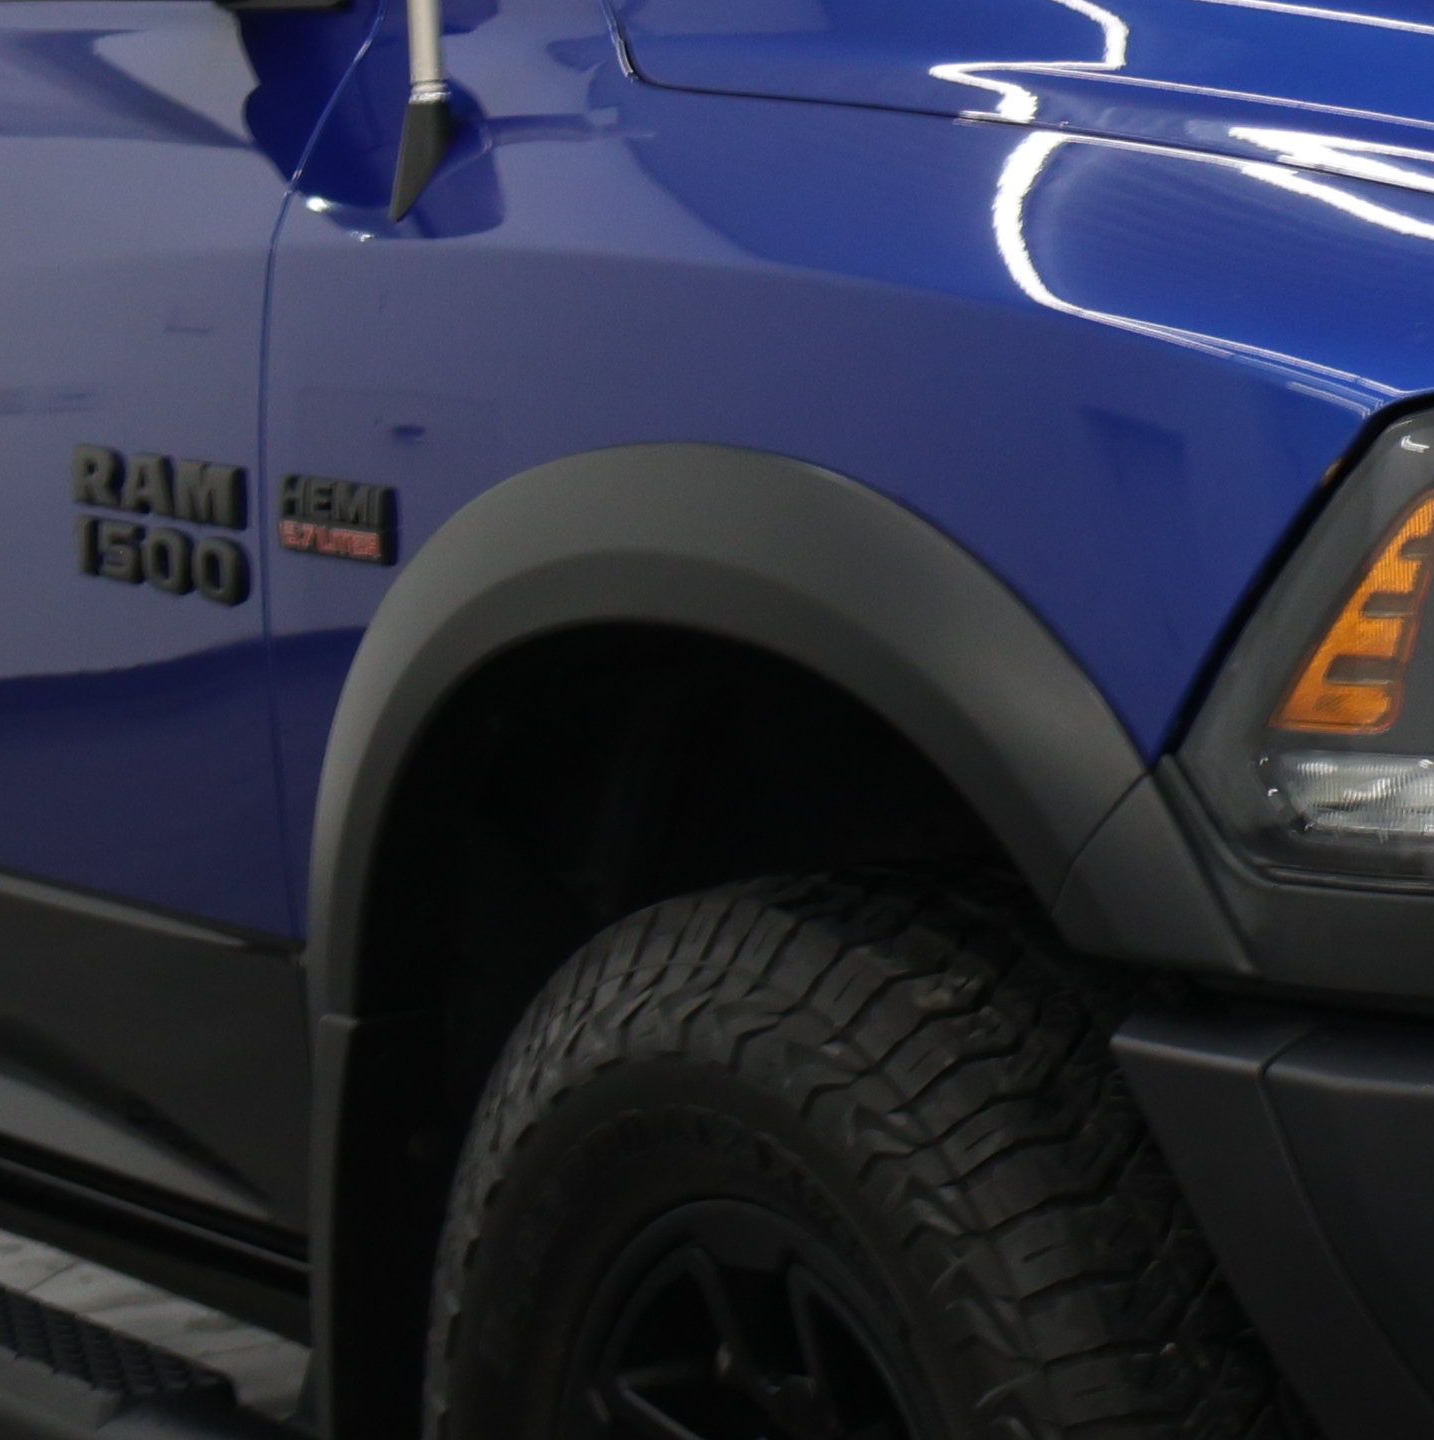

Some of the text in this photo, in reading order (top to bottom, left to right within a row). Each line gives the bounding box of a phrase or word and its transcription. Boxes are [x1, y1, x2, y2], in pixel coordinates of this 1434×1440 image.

[73, 443, 247, 530] RAM
[279, 474, 382, 528] HEMI
[77, 514, 250, 606] 1500
